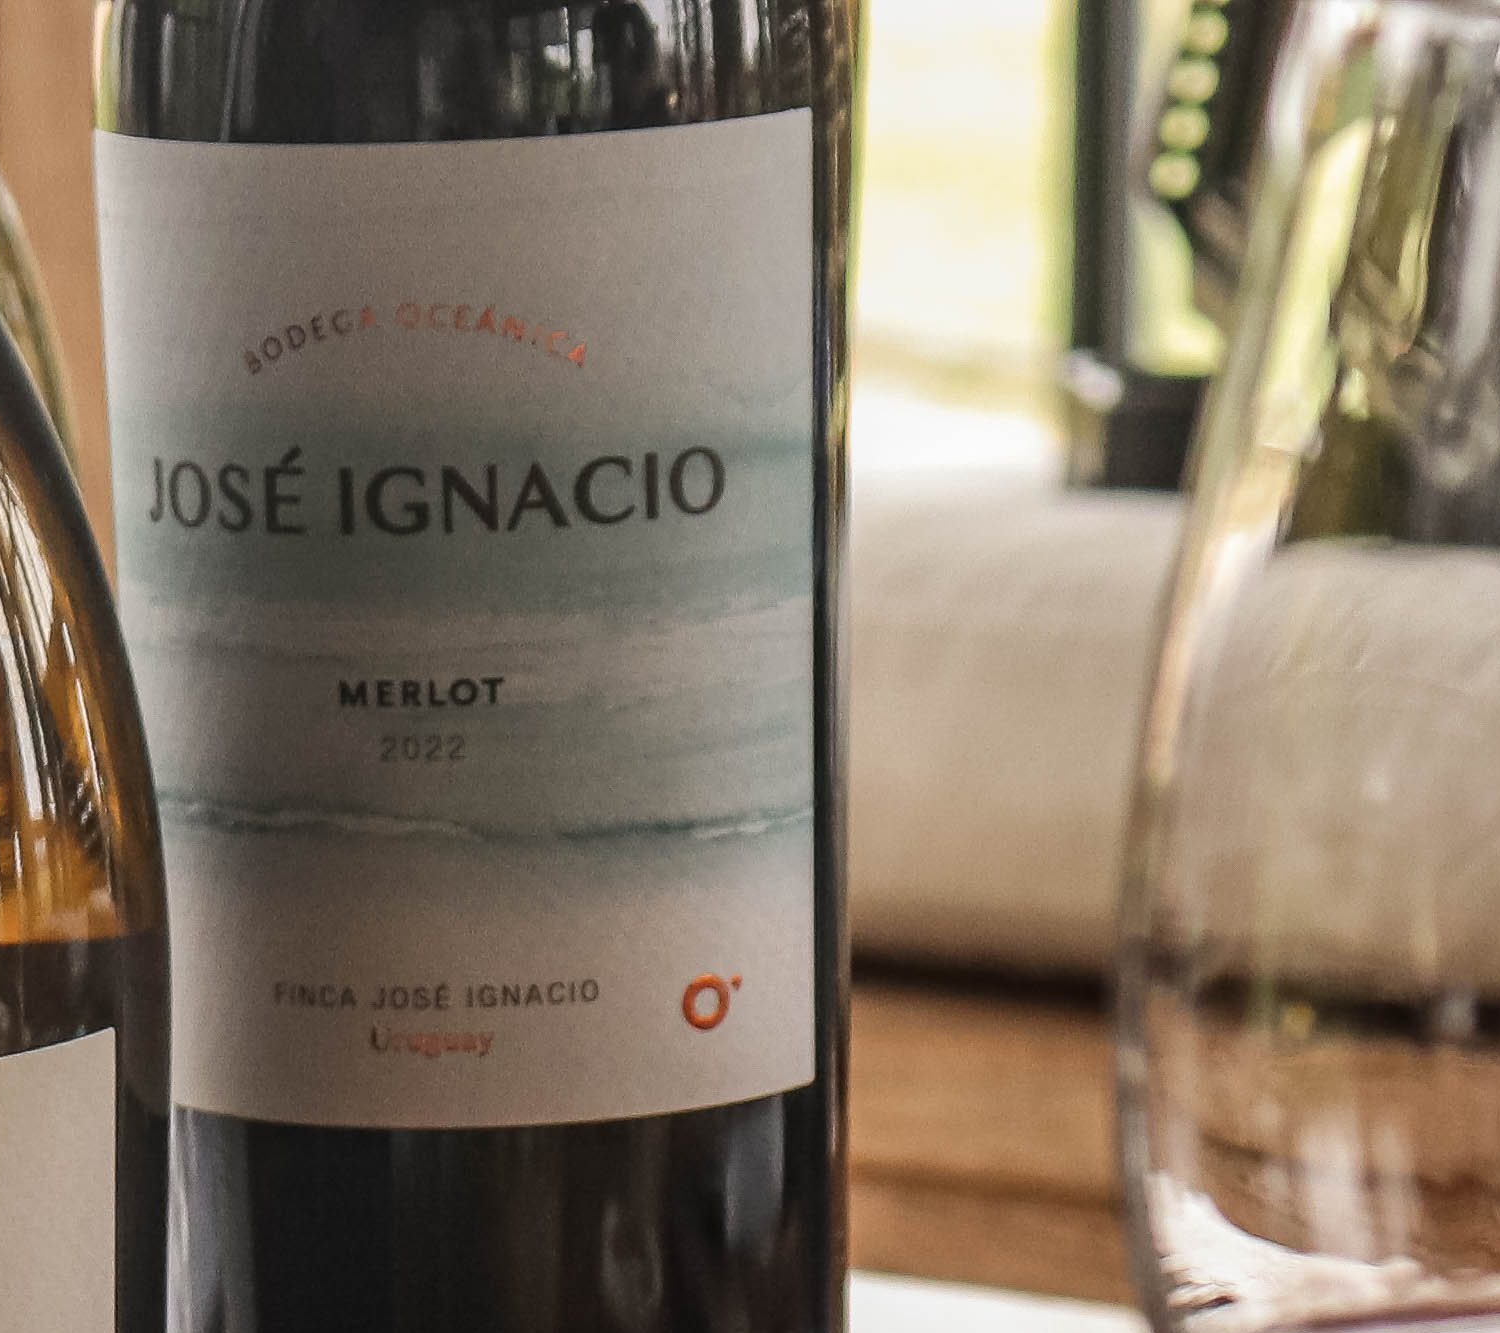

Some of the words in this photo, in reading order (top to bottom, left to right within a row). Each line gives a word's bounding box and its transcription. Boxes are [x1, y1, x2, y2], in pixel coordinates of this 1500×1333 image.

[244, 306, 378, 375] BODEGA
[395, 301, 587, 368] OCEÁNICA
[149, 445, 306, 536] JOSÉ
[338, 445, 727, 536] IGNACIO
[339, 677, 505, 706] MERLOT
[380, 735, 467, 761] 2022
[274, 981, 358, 1010] FINCA
[373, 981, 450, 1011] JOSÉ
[466, 977, 600, 1009] IGNACIO
